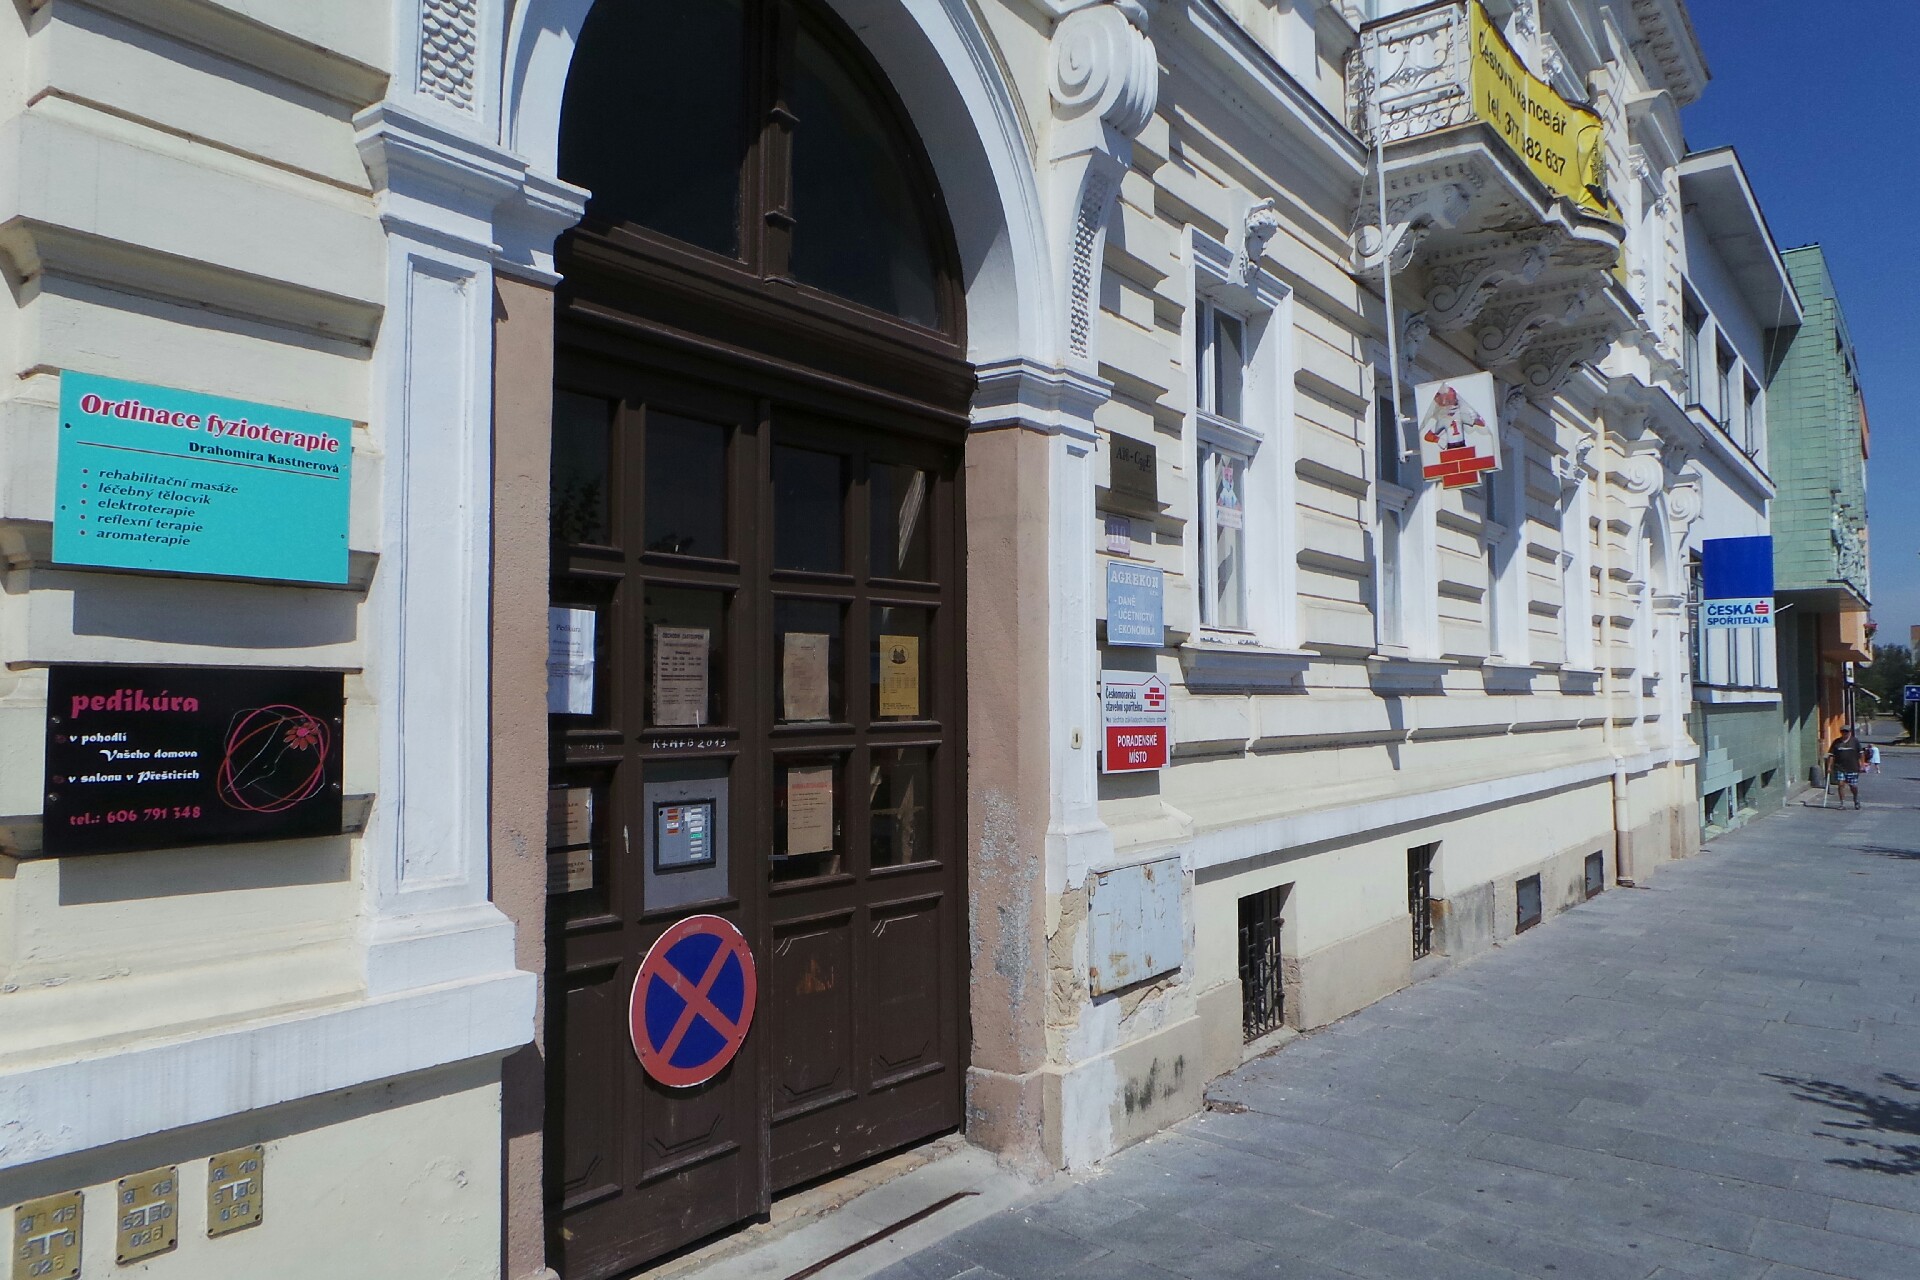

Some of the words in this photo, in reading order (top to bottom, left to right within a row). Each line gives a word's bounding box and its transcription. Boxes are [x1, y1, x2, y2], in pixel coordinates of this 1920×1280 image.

[1504, 112, 1519, 146] 377
[1545, 148, 1566, 176] 637
[80, 393, 201, 429] Ordinace
[206, 414, 339, 453] fyzioterapie
[1450, 420, 1460, 435] 1
[267, 453, 339, 474] Kastnerová
[99, 468, 188, 488] rehabilitační
[191, 479, 239, 494] masáže
[98, 483, 154, 499] léčebný
[158, 490, 211, 505] tělocvik
[98, 499, 196, 518] elektroterapie
[97, 513, 152, 528] reflexní
[156, 520, 203, 533] terapie
[96, 529, 191, 548] aromaterapie
[1111, 570, 1158, 588] AGREKON
[1707, 602, 1754, 616] ČESKÁ
[1707, 615, 1769, 625] SPOŘITELNA
[1119, 625, 1156, 636] EKONOMIKA
[71, 689, 199, 718] pedikúra
[81, 732, 127, 745] pohodlí
[1117, 732, 1158, 747] PORADENSKÉ
[100, 749, 150, 762] Vašeho
[154, 750, 198, 759] domova
[1129, 749, 1147, 763] MÍSTO
[68, 775, 77, 783] v
[81, 771, 122, 783] salonu
[126, 773, 133, 782] v
[137, 769, 199, 784] Přešticích
[70, 811, 100, 826] tel.:
[107, 810, 137, 823] 606
[144, 808, 167, 821] 791
[174, 806, 201, 820] 348
[53, 1204, 76, 1222] 15
